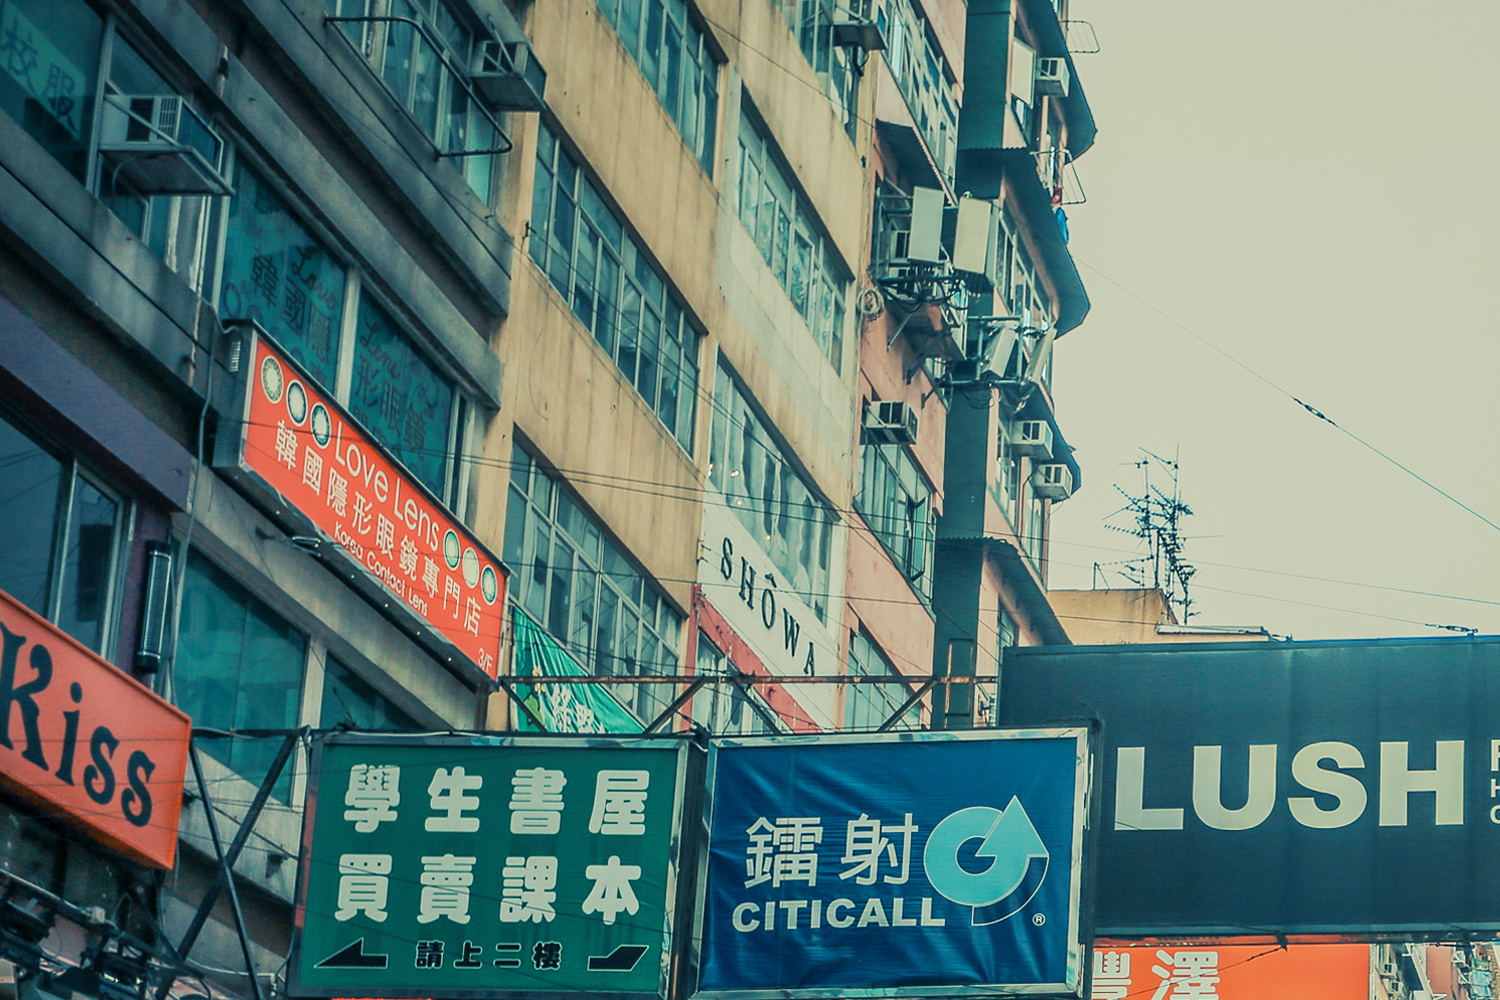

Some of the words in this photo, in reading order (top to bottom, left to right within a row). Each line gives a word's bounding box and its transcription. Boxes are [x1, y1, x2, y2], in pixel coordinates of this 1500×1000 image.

[335, 421, 389, 503] Love
[393, 477, 440, 552] Lens
[275, 419, 481, 638] 韓國隱形眼鏡專門店
[334, 521, 363, 560] Korea
[366, 550, 406, 598] Contact
[408, 582, 429, 617] Lens
[477, 647, 494, 673] 3/F
[0, 619, 157, 828] Kiss
[343, 762, 650, 836] 學生書屋
[1114, 739, 1465, 831] LUSH
[334, 852, 642, 926] 買賣課本
[744, 812, 919, 889] 鐳射
[732, 896, 946, 933] CITICALL
[414, 939, 563, 971] 請上二樓
